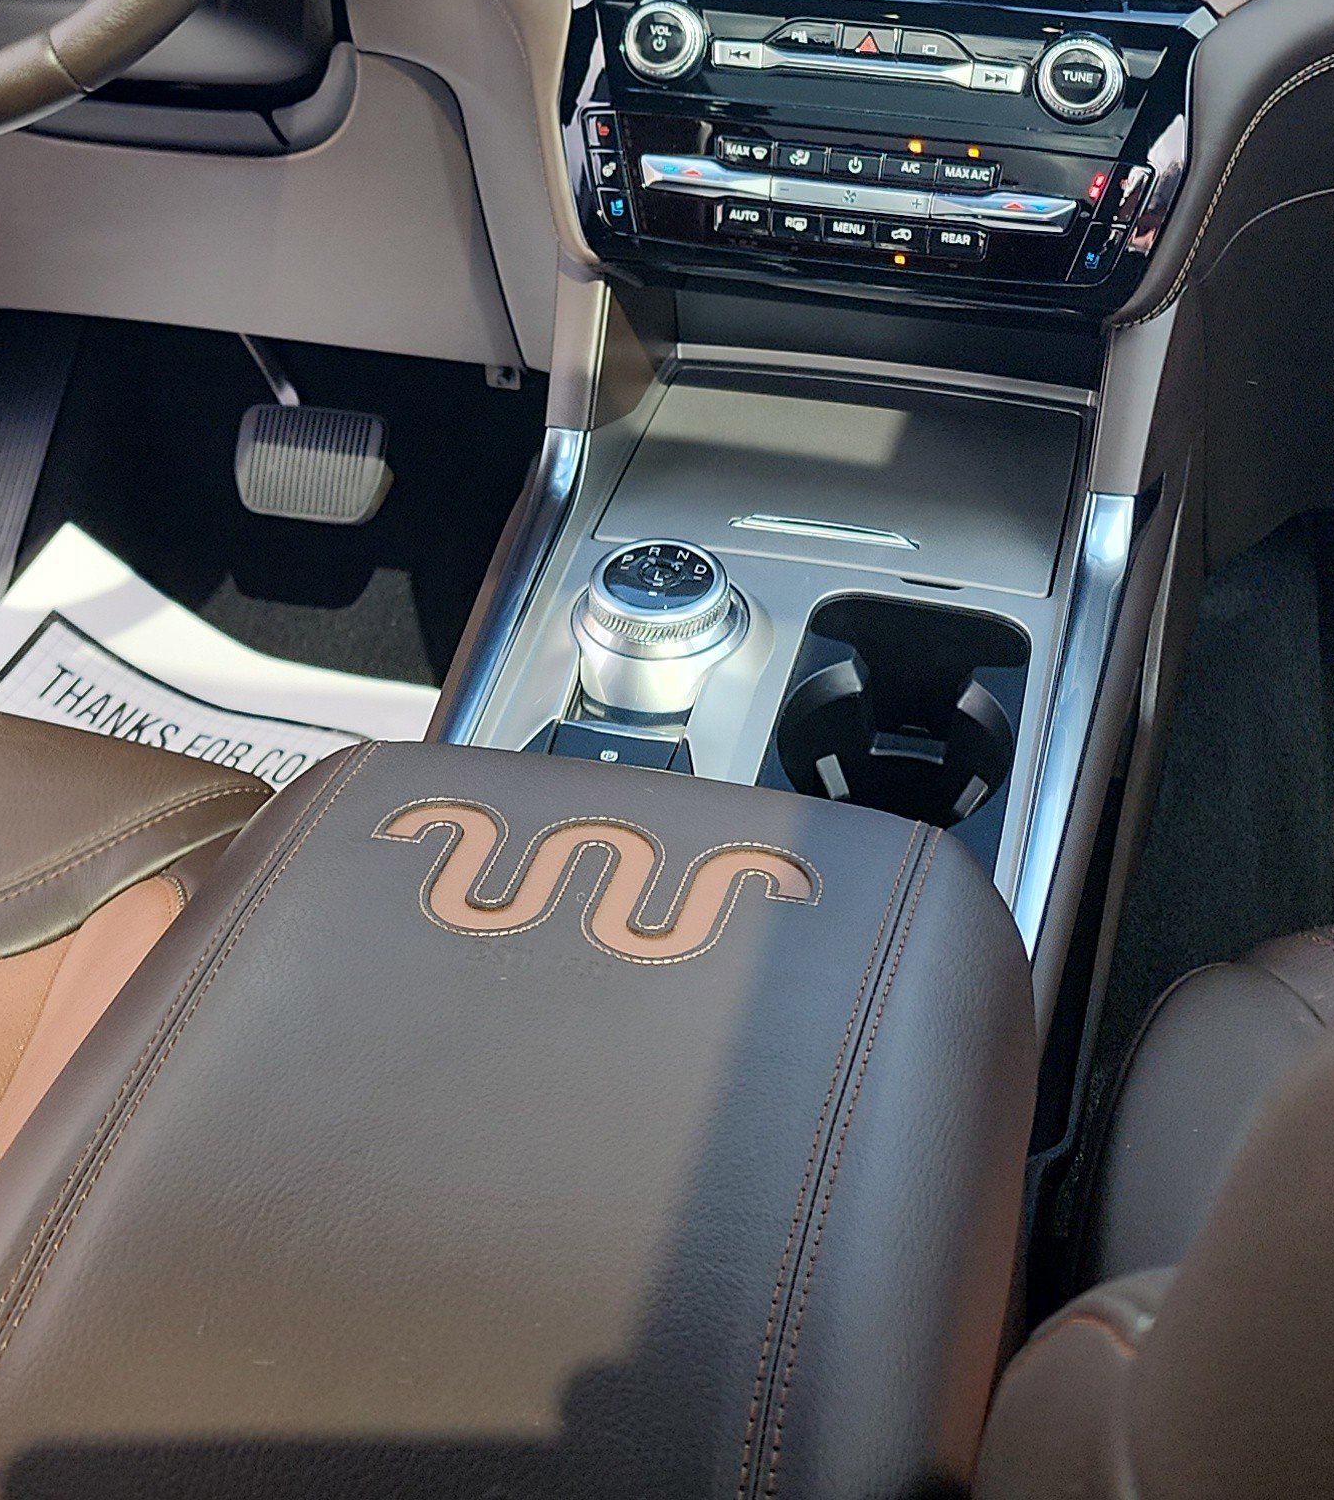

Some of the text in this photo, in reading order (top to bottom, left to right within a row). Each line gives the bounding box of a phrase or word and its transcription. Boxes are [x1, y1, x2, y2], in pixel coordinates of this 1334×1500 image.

[650, 25, 672, 37] VOL
[1062, 70, 1094, 84] TUNE
[726, 145, 750, 157] MAX
[901, 161, 921, 175] A/C
[944, 166, 991, 182] MAX A/C
[729, 209, 760, 223] AUTO
[833, 221, 866, 235] MENU
[940, 232, 971, 246] REAR
[648, 546, 661, 557] R
[676, 550, 690, 560] N
[620, 554, 635, 564] P
[653, 570, 664, 582] L
[693, 564, 708, 575] D
[39, 663, 181, 750] THANKS
[183, 733, 253, 770] FOR
